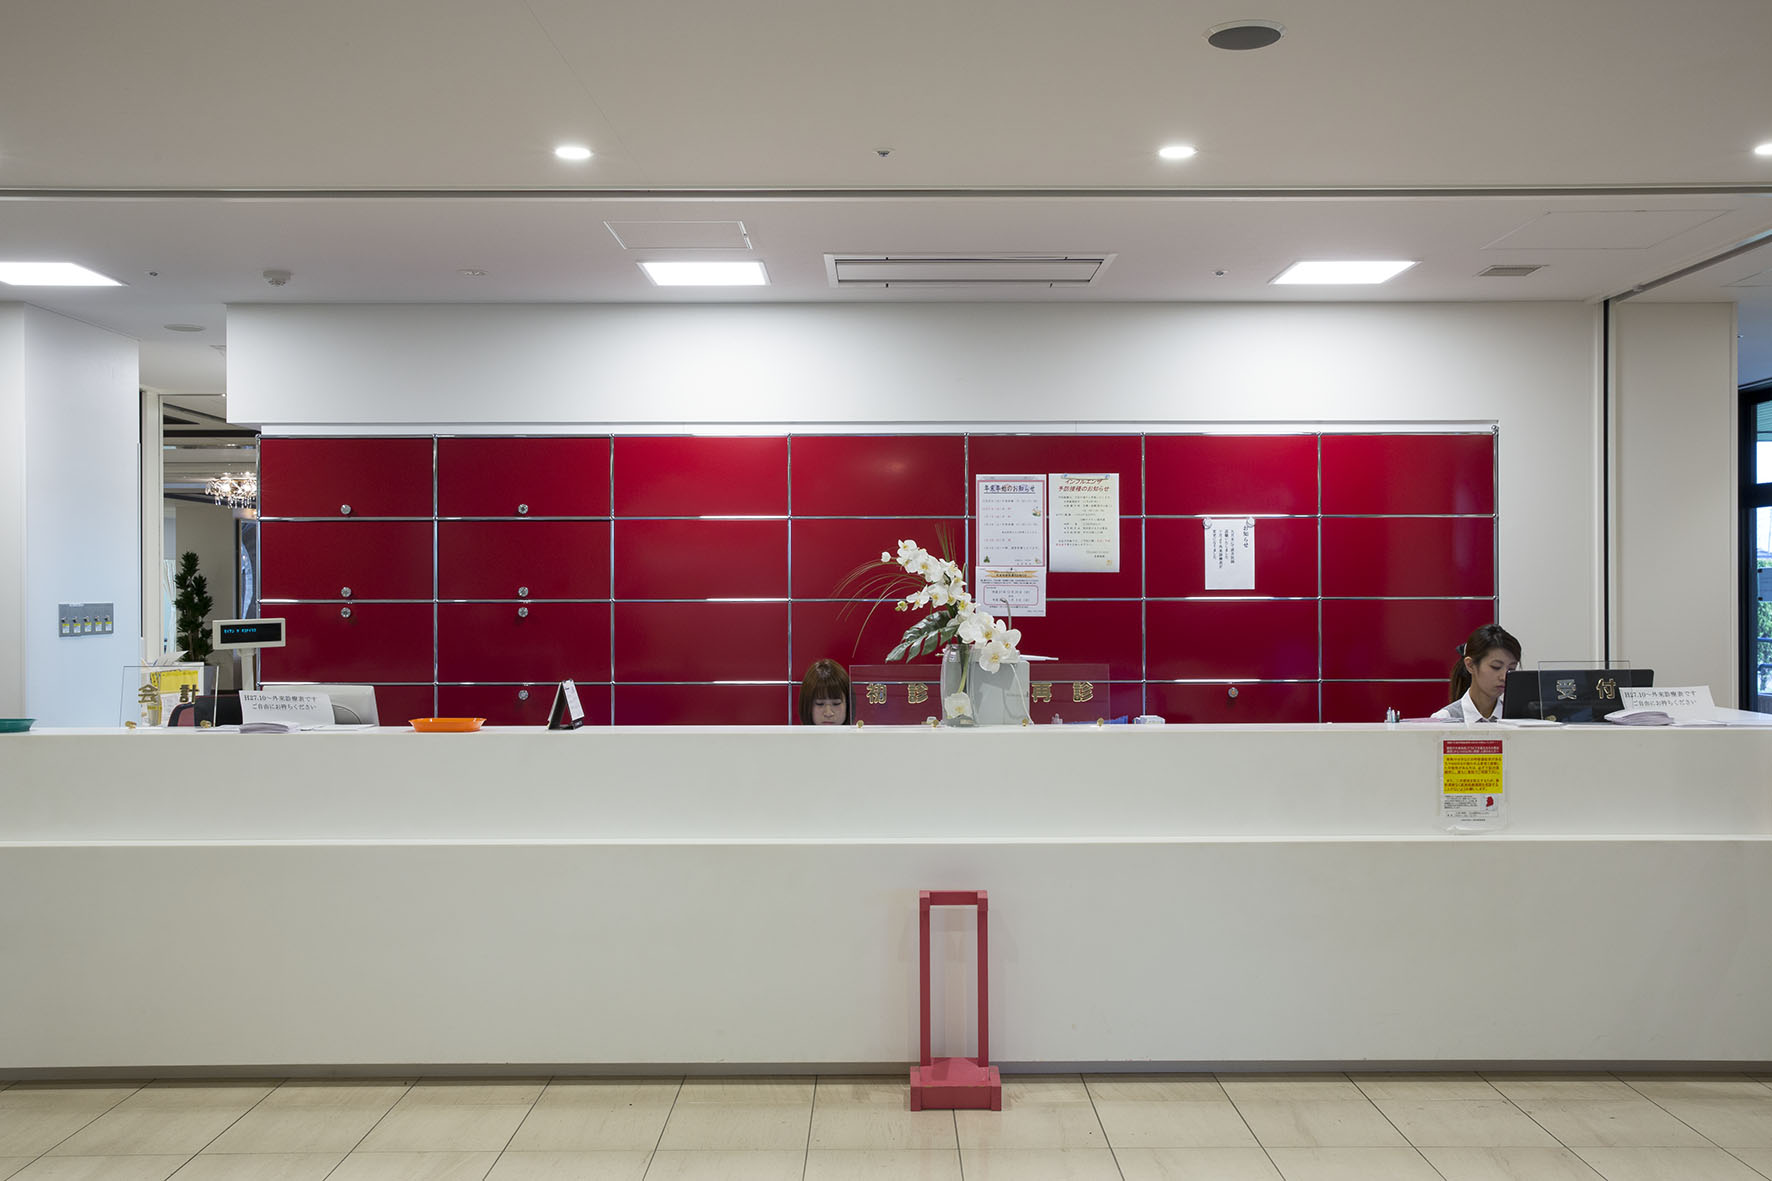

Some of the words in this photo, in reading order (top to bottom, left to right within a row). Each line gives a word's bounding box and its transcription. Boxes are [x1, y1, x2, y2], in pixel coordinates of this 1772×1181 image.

[138, 684, 200, 704] 会計
[866, 682, 929, 704] 初診
[1031, 681, 1094, 703] 再診
[1556, 678, 1616, 700] 受付
[252, 703, 317, 711] ご自由にお持ちください
[1633, 699, 1697, 707] ご自由にお持ちください
